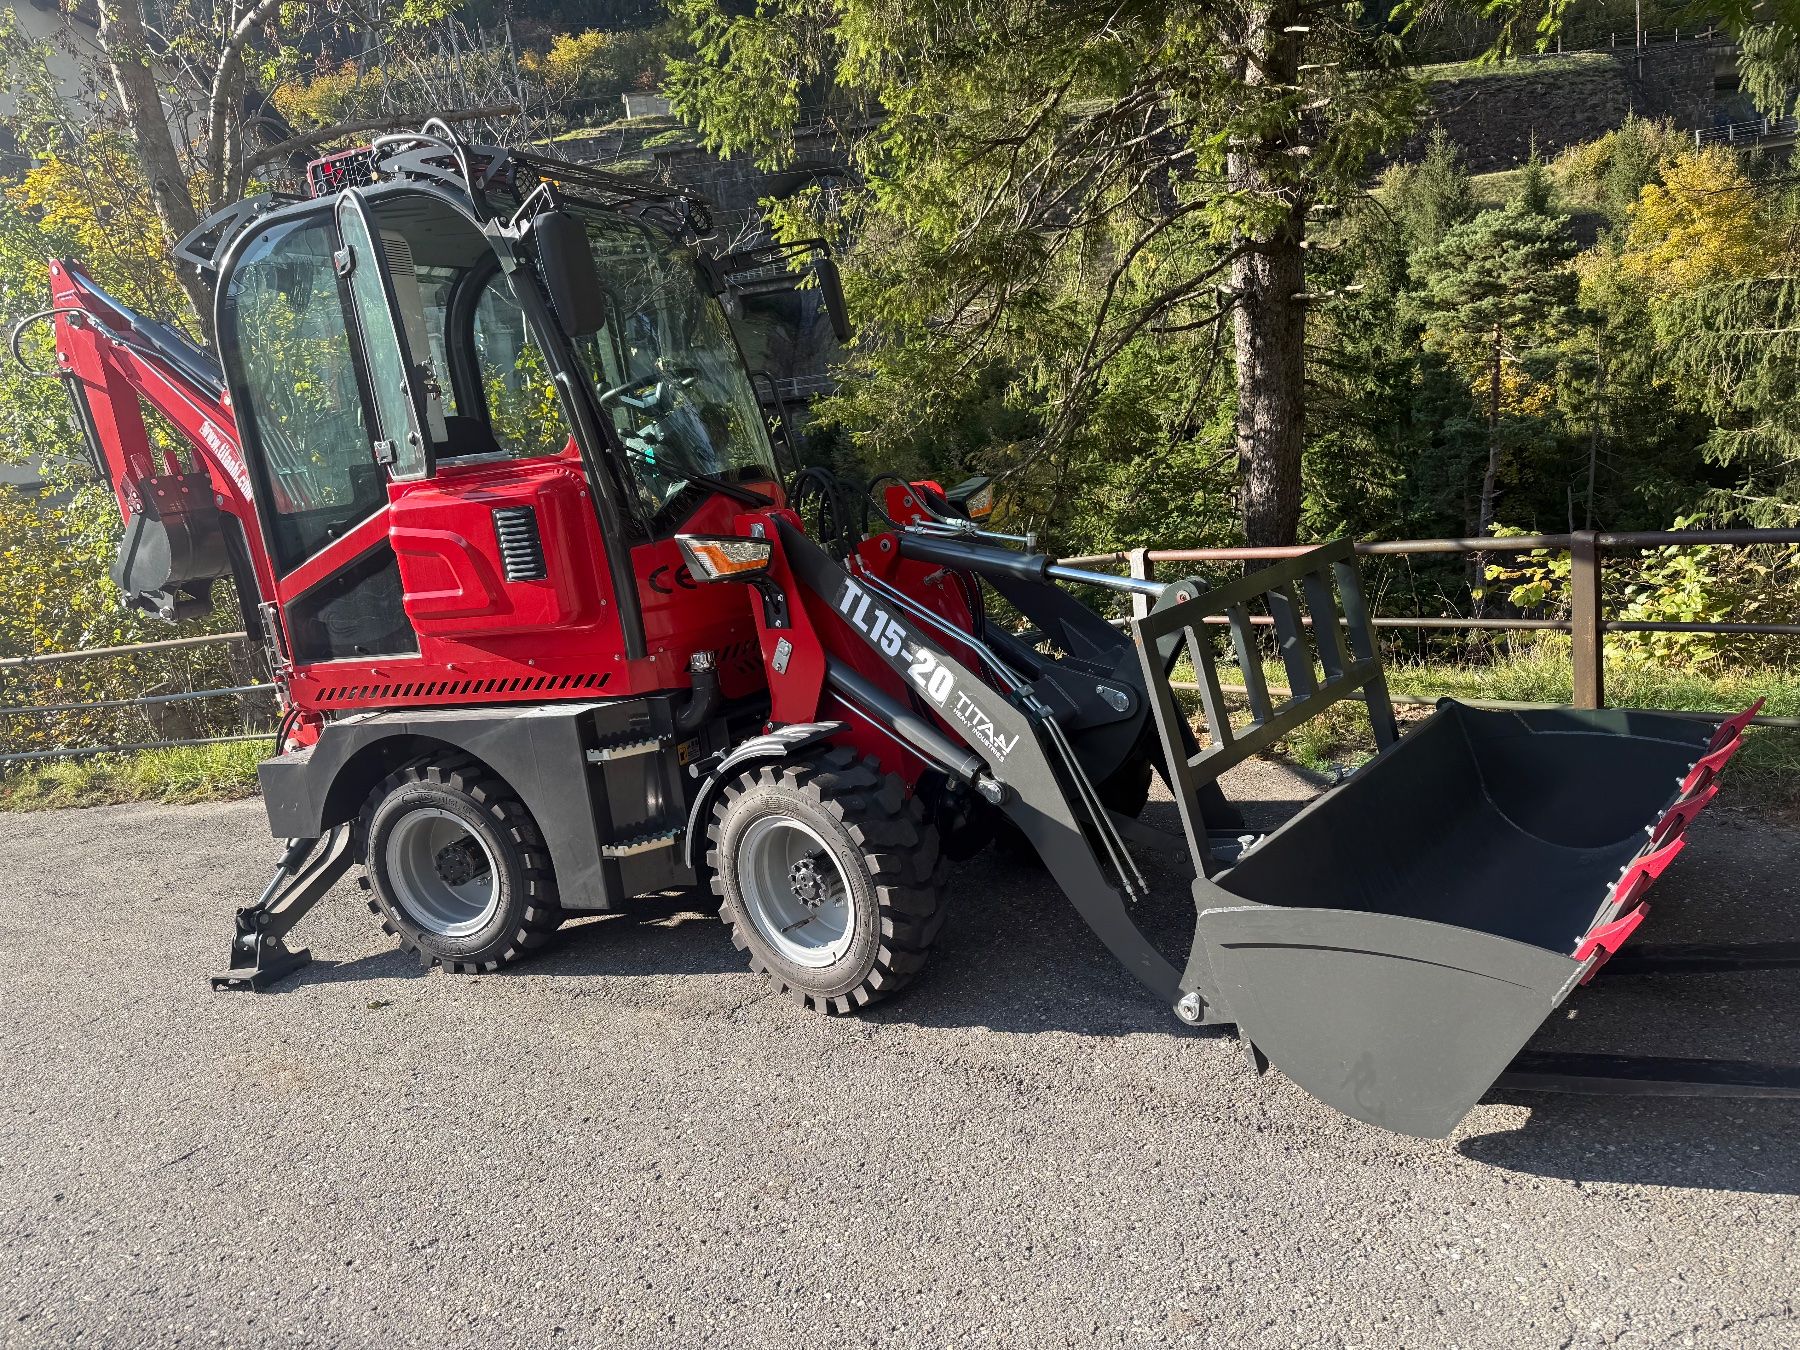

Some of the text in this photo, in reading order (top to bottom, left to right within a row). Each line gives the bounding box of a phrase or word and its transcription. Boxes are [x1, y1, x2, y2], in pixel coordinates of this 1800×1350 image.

[839, 577, 954, 706] TL15-20
[952, 707, 1005, 763] HEAVY INDUSTRIES
[956, 690, 1020, 756] TITAN
